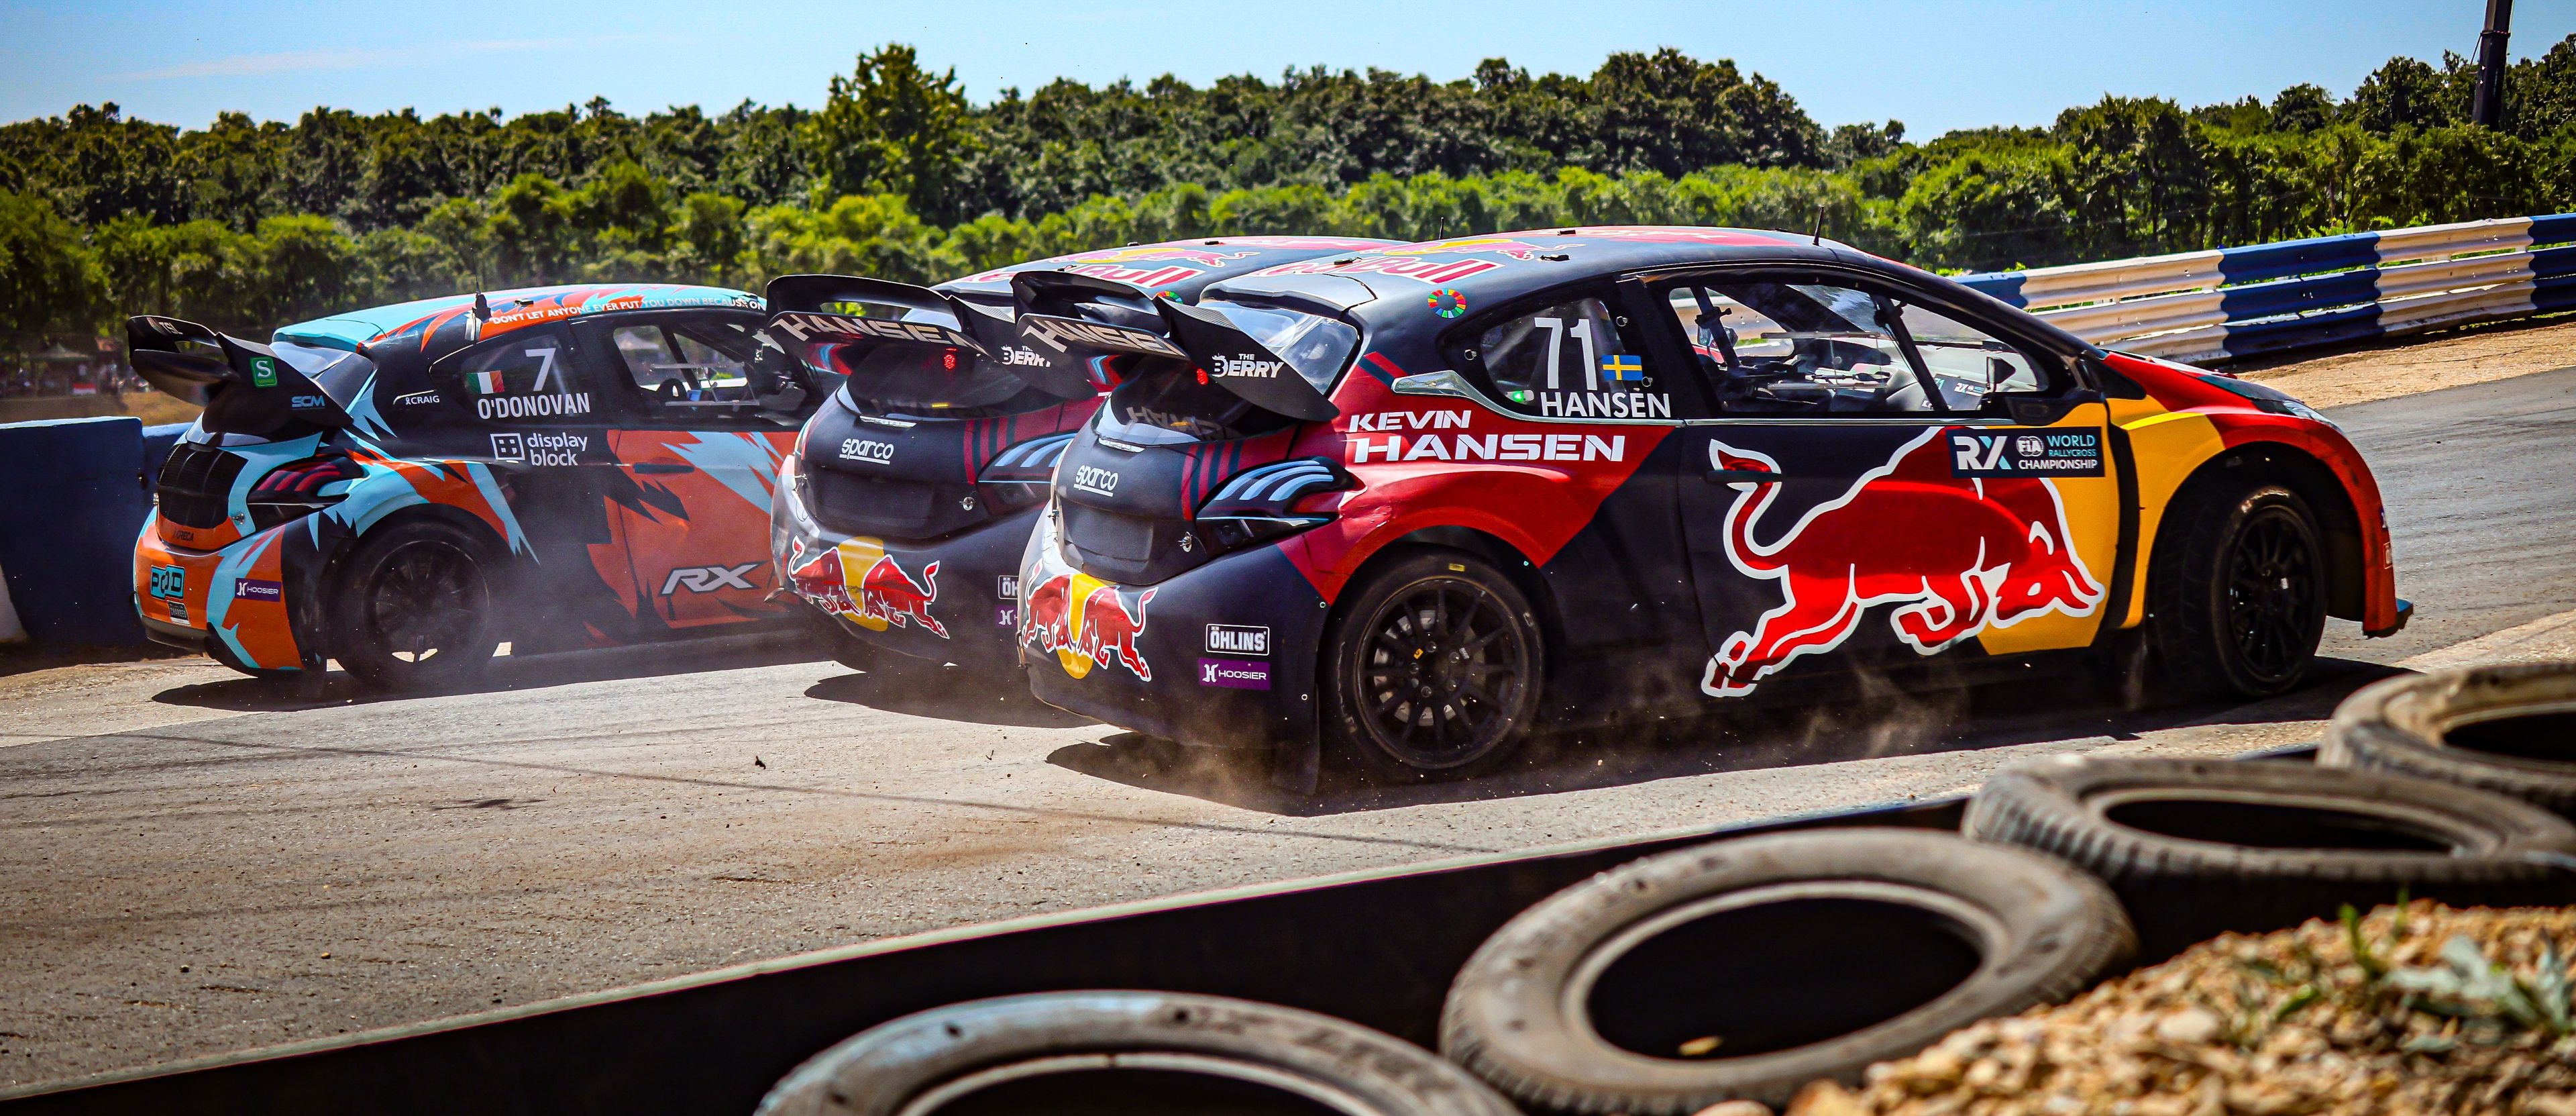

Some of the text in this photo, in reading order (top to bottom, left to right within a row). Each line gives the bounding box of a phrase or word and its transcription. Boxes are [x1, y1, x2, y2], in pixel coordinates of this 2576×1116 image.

[529, 311, 543, 319] LET
[548, 303, 592, 317] ANYONE
[594, 302, 620, 311] EVER
[621, 301, 639, 309] PUT
[642, 299, 664, 307] YOU
[667, 297, 699, 306] DOWN
[1534, 317, 1597, 391] 71
[256, 360, 272, 377] S
[525, 348, 556, 391] 7
[1212, 356, 1285, 378] BERRY
[292, 395, 325, 407] SCM
[411, 395, 440, 404] CRAIG
[478, 393, 590, 419] O'DONOVAN
[1540, 392, 1671, 418] HANSEN
[1349, 410, 1472, 433] KEVIN
[527, 433, 588, 452] display
[841, 438, 894, 460] sparco
[1349, 434, 1626, 463] HANSEN
[2047, 436, 2095, 447] WORLD
[530, 450, 578, 466] block
[1953, 436, 2012, 470] RX
[2049, 449, 2096, 457] RALLYCROSS
[2019, 460, 2098, 470] CHAMPIONSHIP
[1075, 465, 1118, 491] sparco
[660, 564, 759, 595] RX
[247, 587, 279, 595] HOOSIER
[1210, 626, 1265, 652] ÖHLINS
[1218, 670, 1267, 680] HOOSIER
